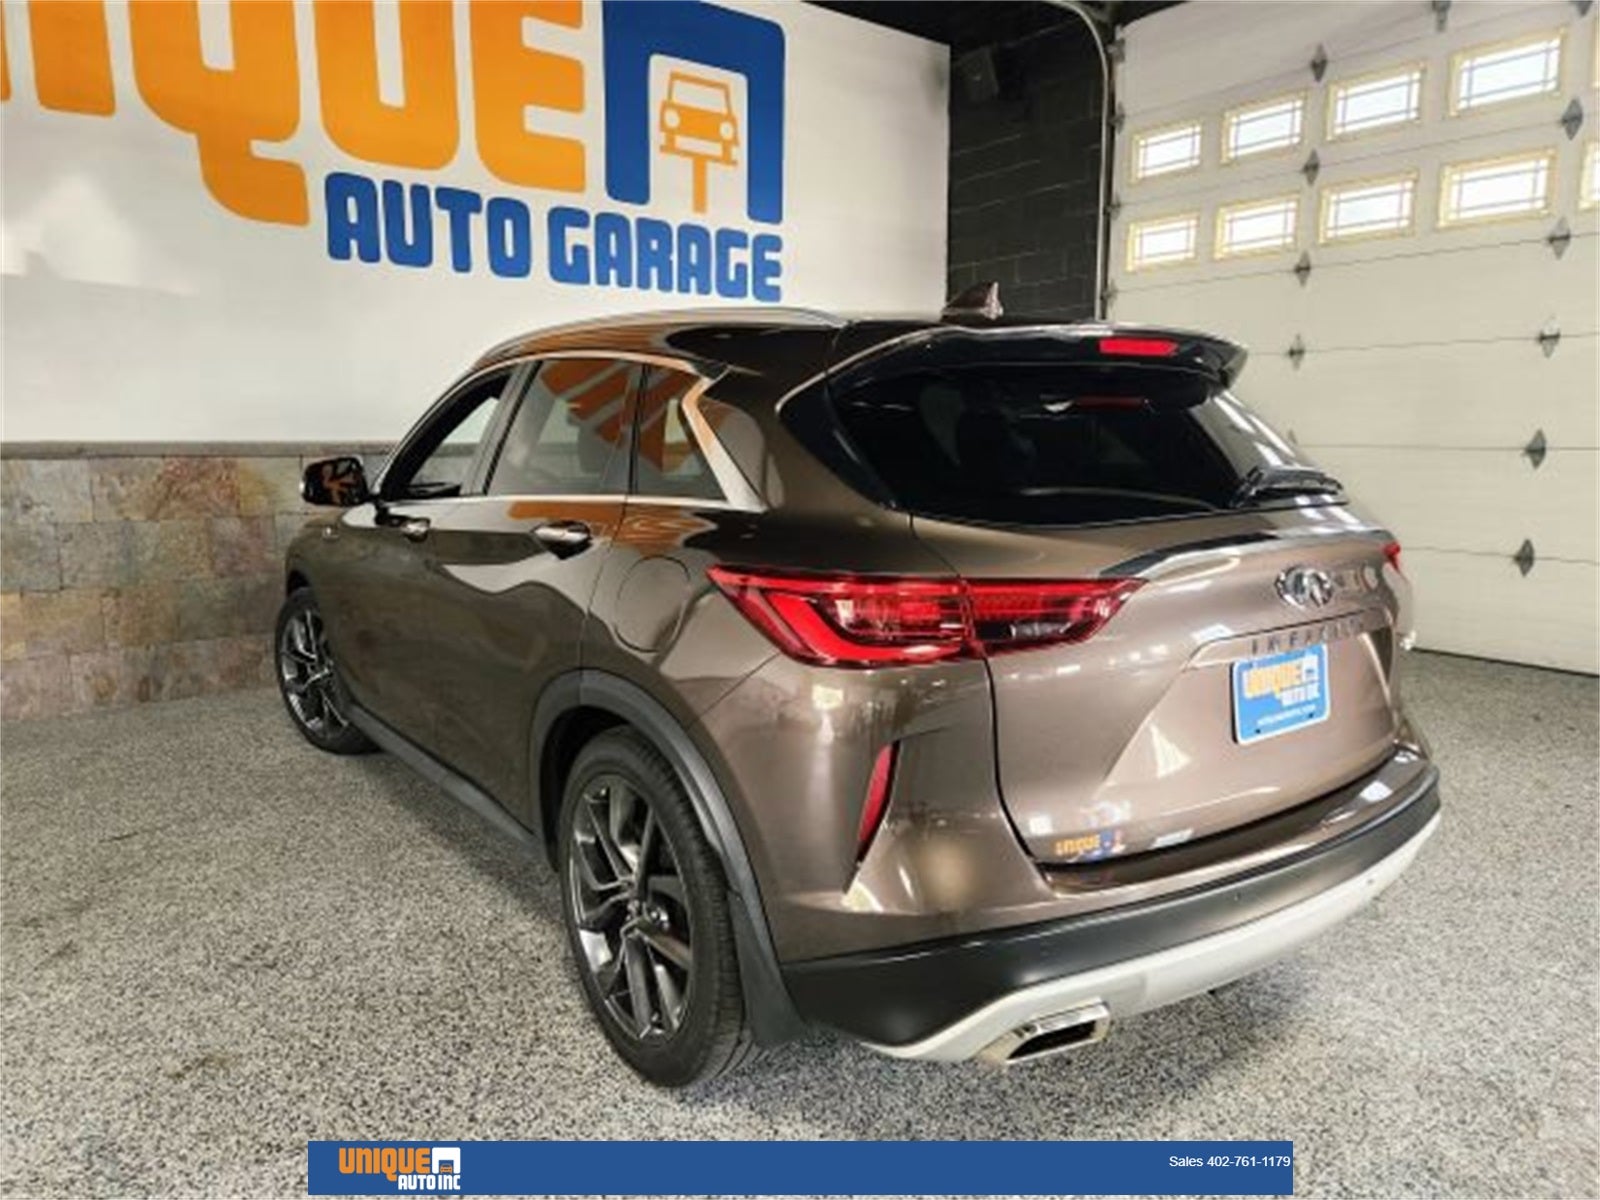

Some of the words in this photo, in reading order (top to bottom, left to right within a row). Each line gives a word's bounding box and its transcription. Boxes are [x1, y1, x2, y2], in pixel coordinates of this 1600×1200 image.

[0, 0, 588, 227] QUE
[324, 172, 532, 279] AUTO
[547, 207, 783, 303] GARAGE
